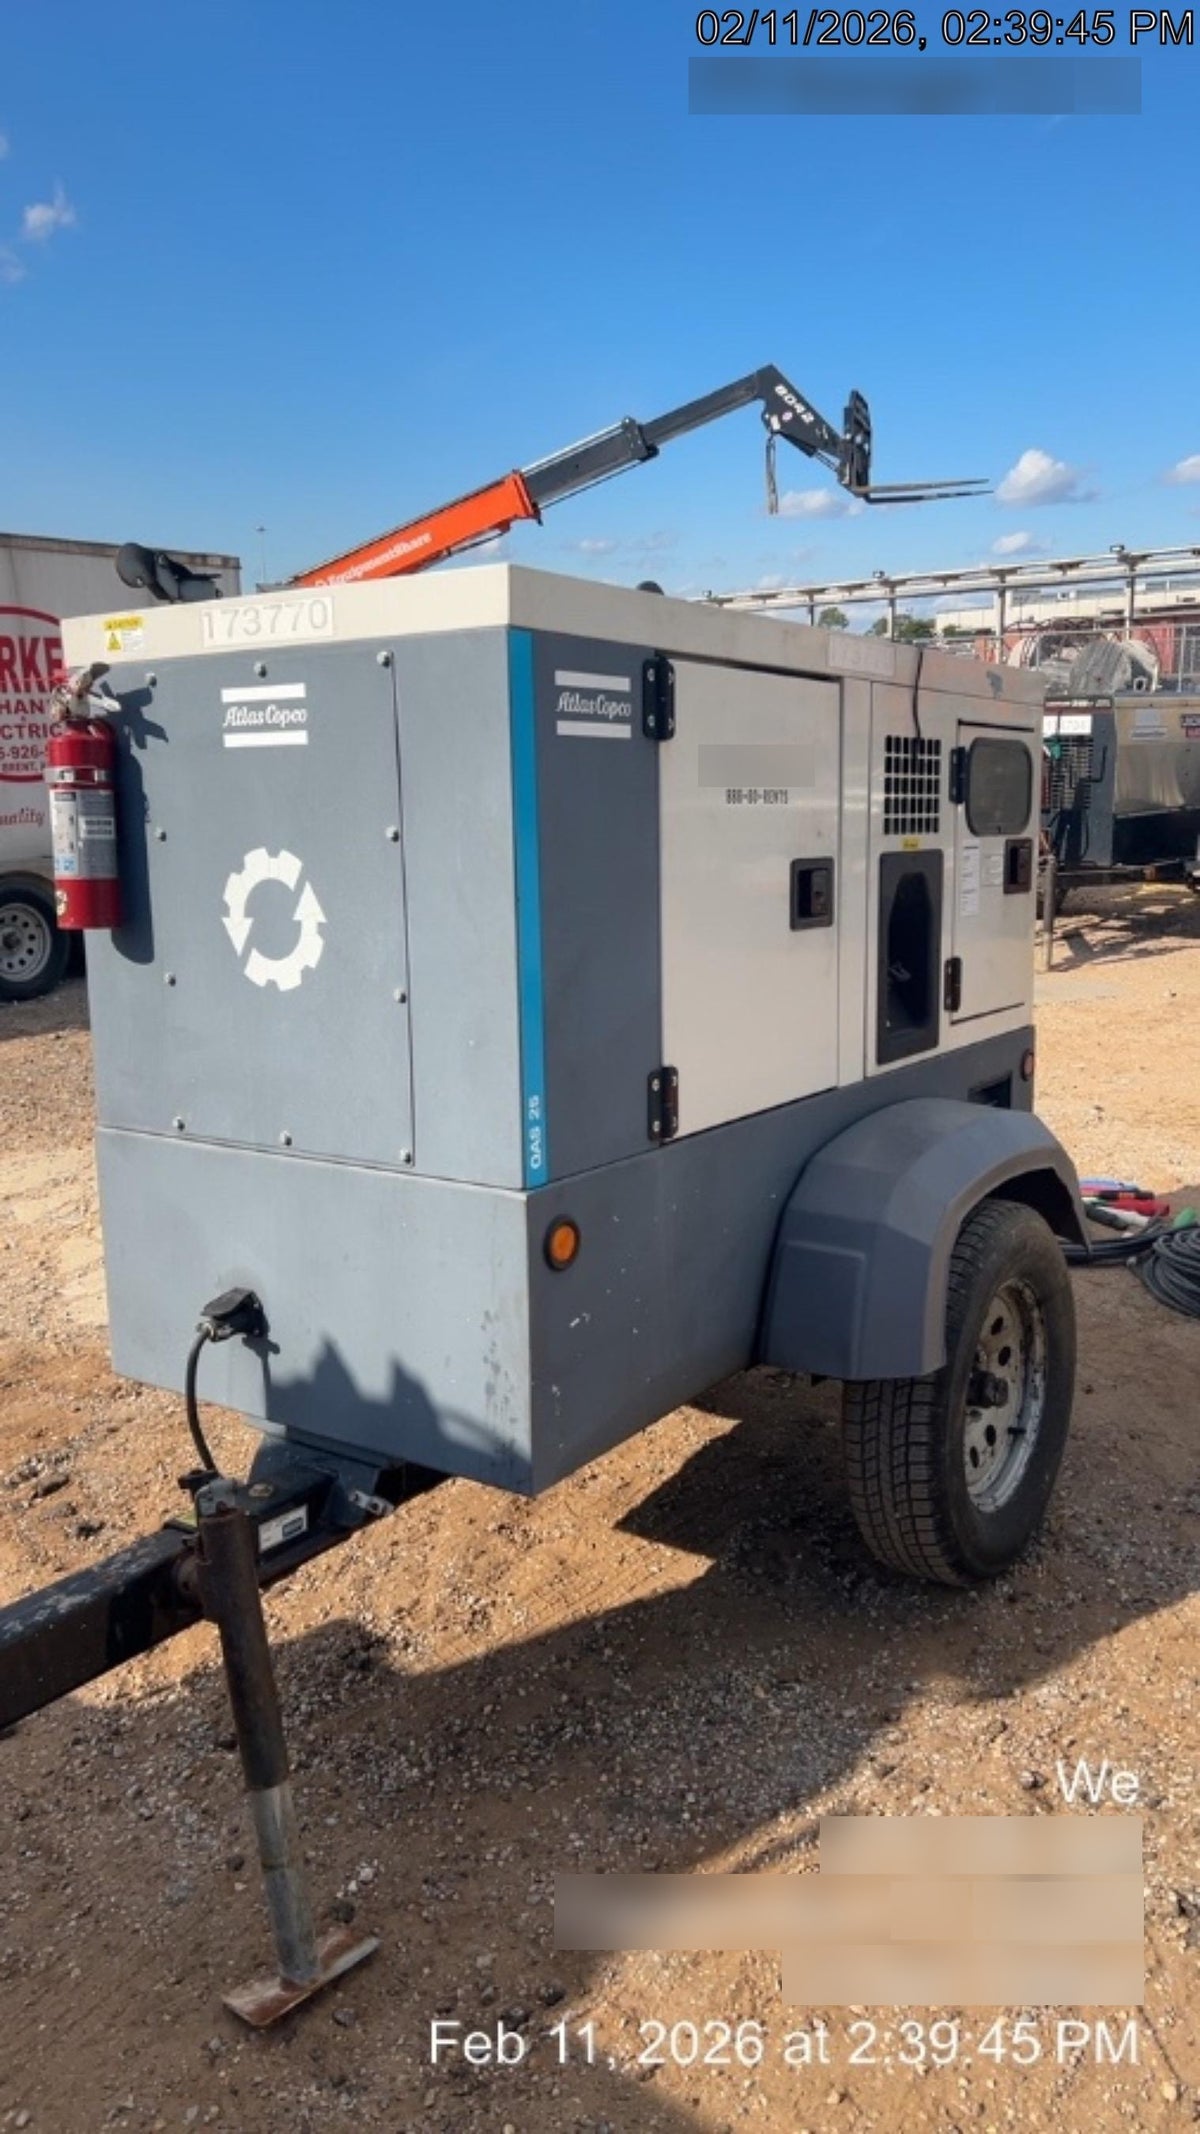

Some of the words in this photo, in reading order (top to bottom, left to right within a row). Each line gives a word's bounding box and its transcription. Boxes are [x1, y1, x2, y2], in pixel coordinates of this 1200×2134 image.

[203, 599, 329, 639] 173770
[222, 705, 264, 728] Atlas
[265, 703, 307, 729] Copco
[555, 691, 595, 714] Atlas
[596, 693, 632, 720] Copco
